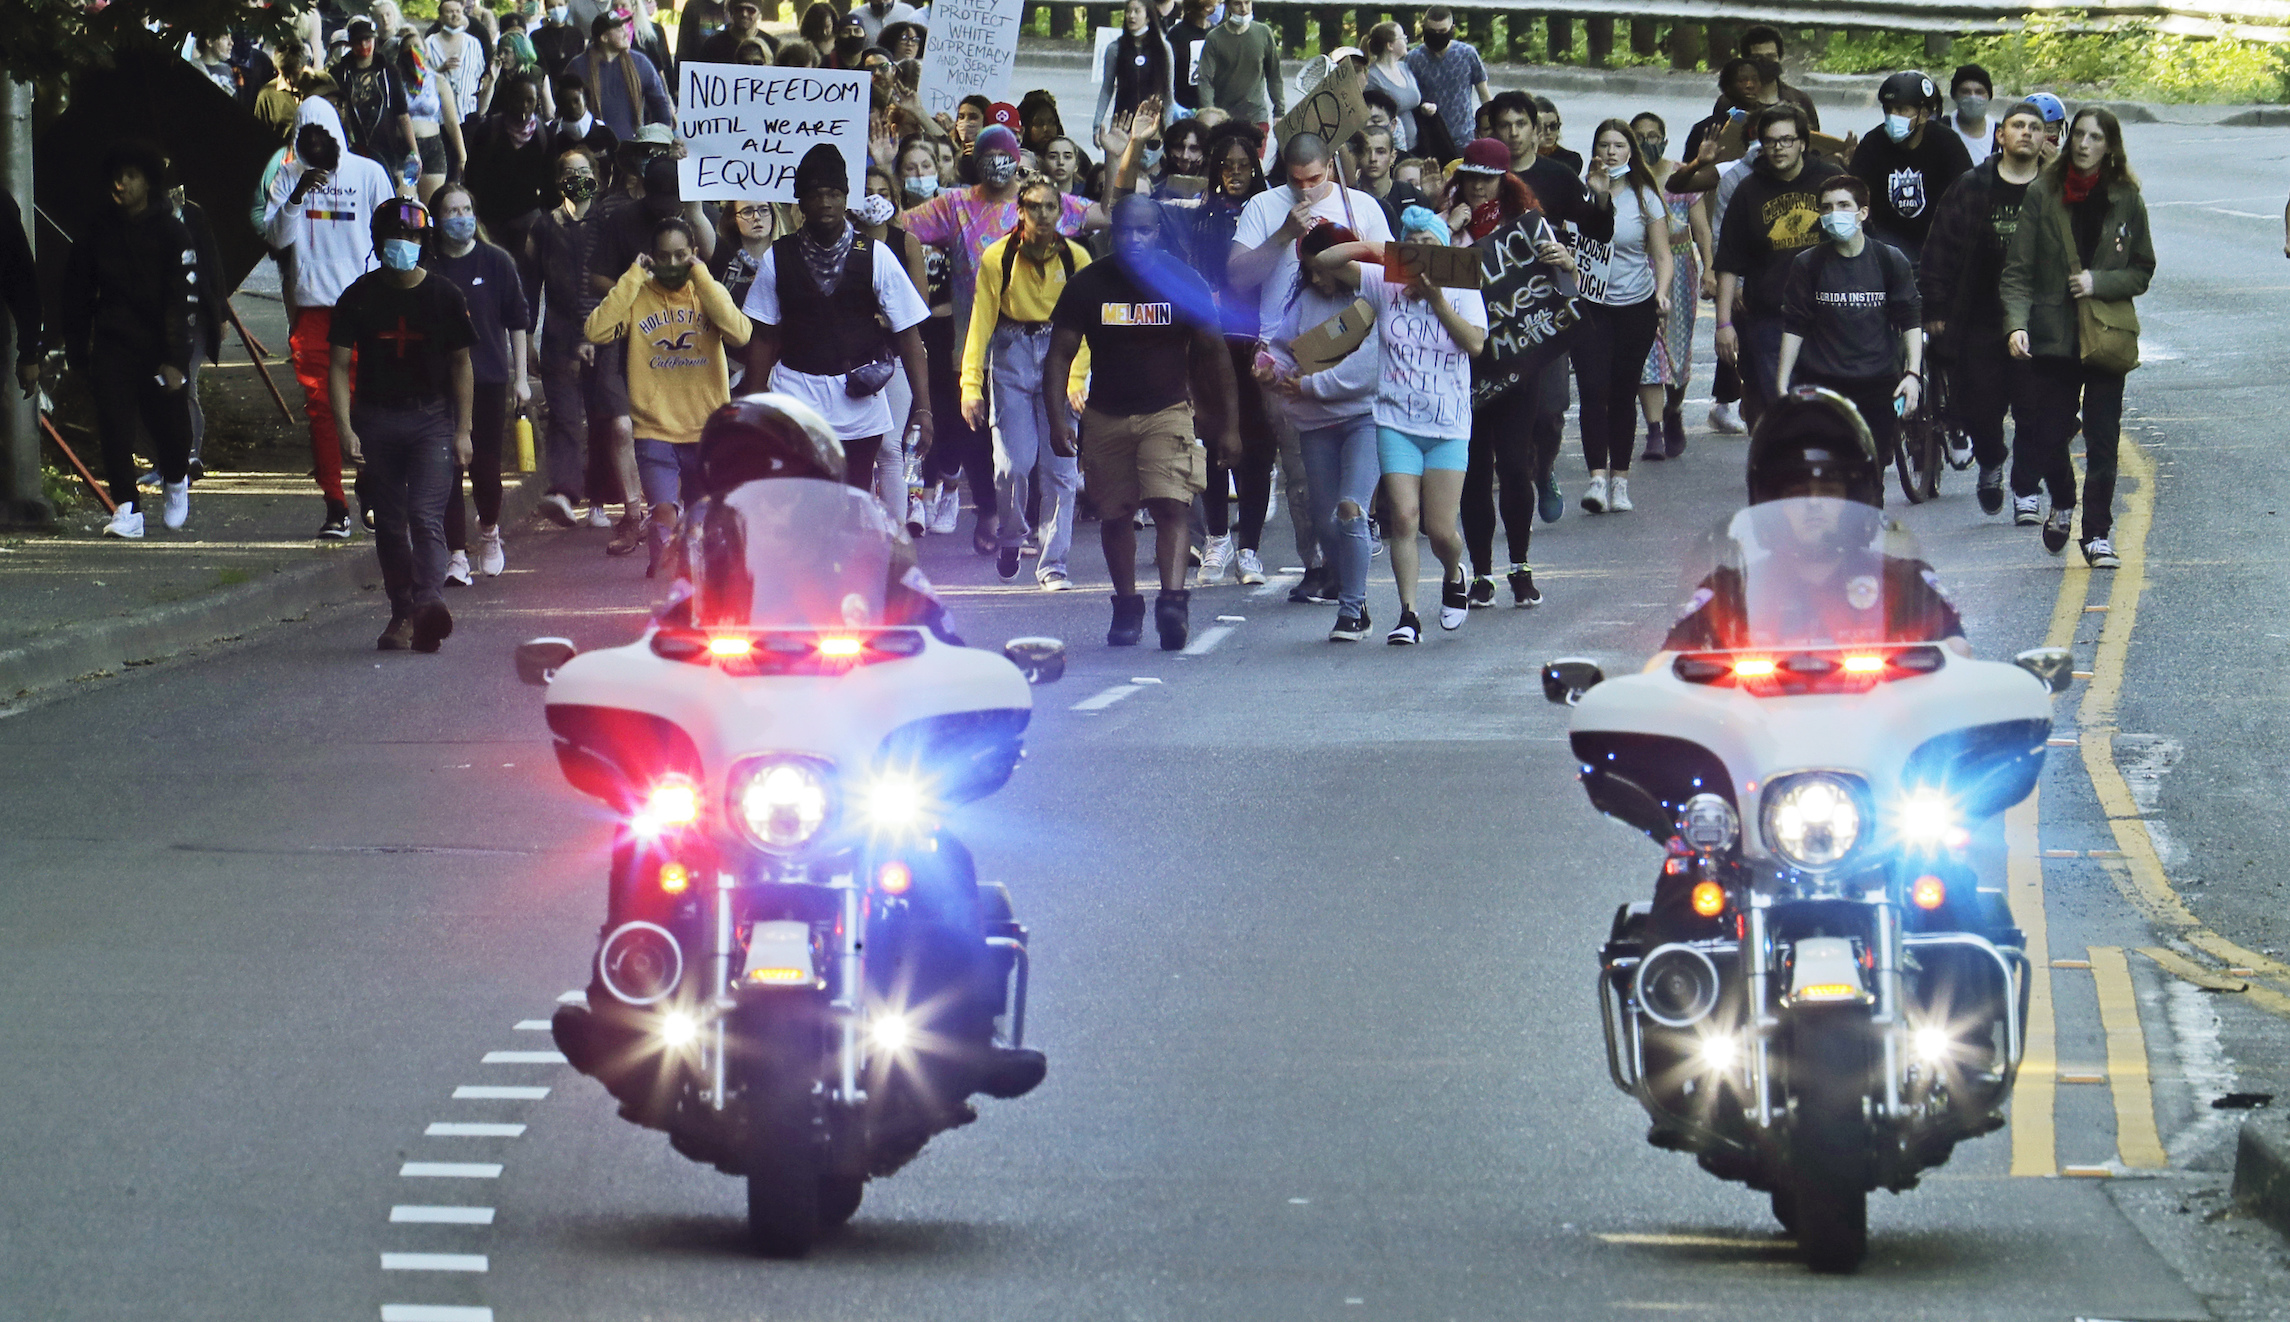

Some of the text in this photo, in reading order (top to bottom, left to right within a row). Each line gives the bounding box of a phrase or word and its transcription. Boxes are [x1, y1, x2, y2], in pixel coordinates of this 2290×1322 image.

[940, 5, 1013, 27] PROTECT
[949, 22, 995, 45] WHITE
[927, 36, 1010, 65] SUPREMACY
[937, 55, 998, 76] AND SERVE
[690, 70, 860, 109] NO FREEDOM
[947, 69, 987, 90] MONEY
[795, 119, 850, 137] ARE
[741, 138, 794, 154] ALL
[698, 156, 798, 190] EQUA
[1481, 218, 1548, 284] LACK
[1577, 254, 1591, 271] IS
[1398, 246, 1478, 286] BLM
[1101, 302, 1171, 326] MELANIN
